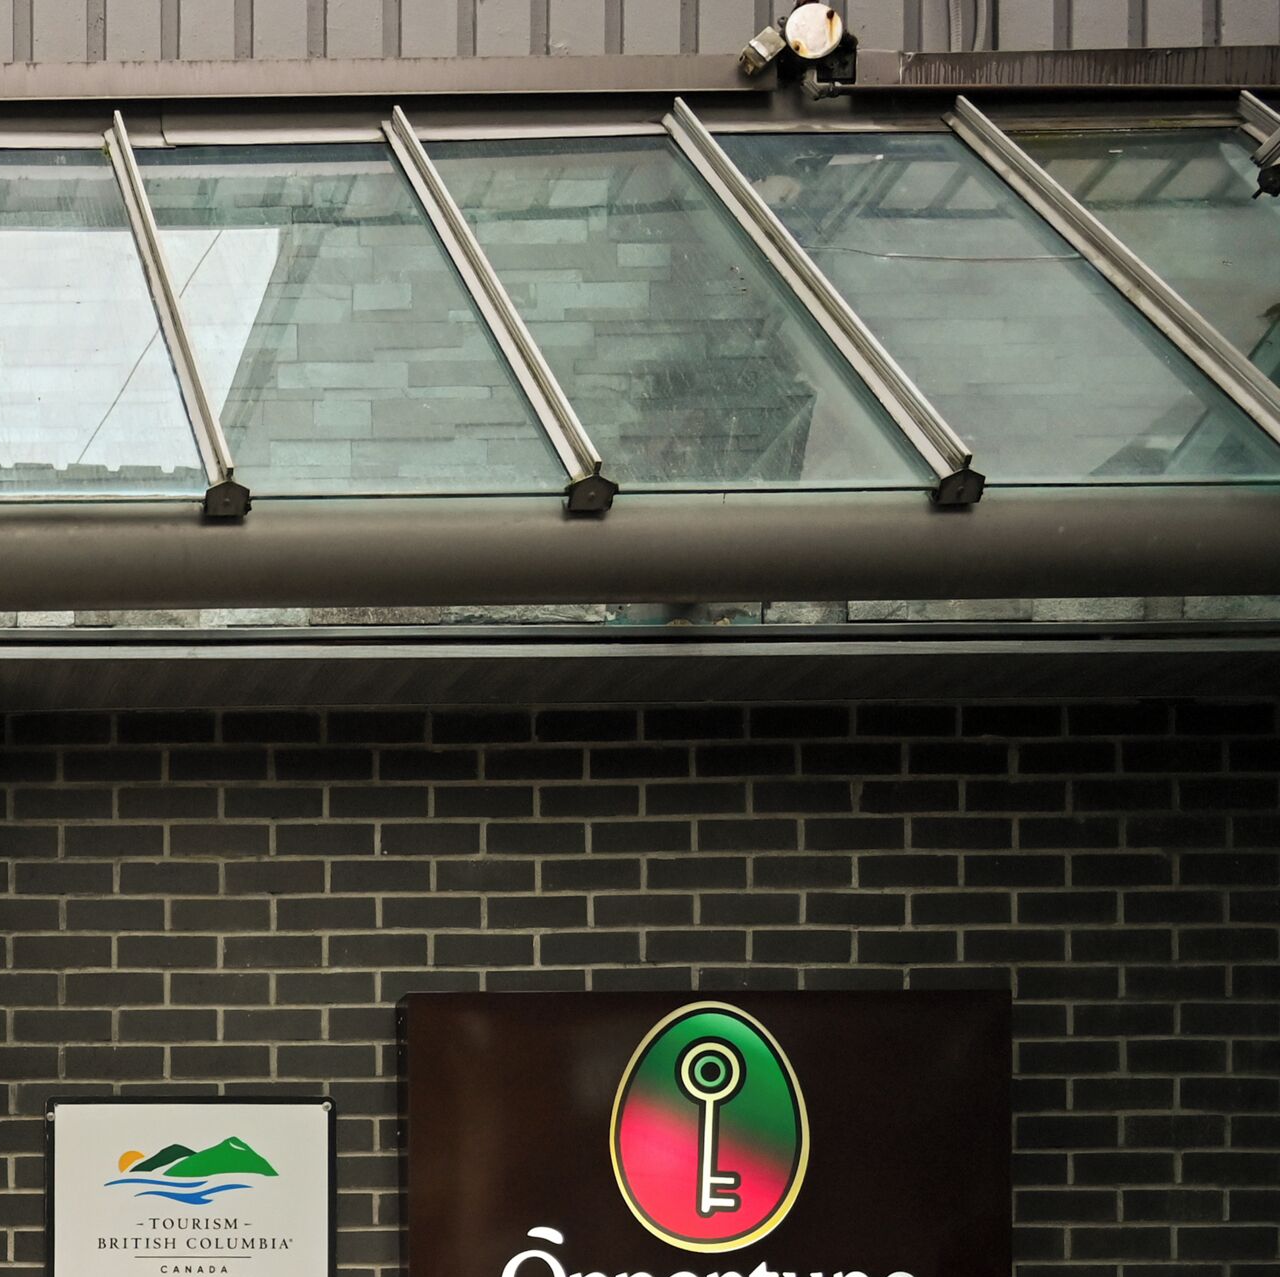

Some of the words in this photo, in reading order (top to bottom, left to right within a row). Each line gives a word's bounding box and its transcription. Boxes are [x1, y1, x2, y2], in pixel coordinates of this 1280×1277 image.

[148, 1218, 239, 1230] TOURISM
[97, 1237, 177, 1250] BRITISH
[160, 1265, 229, 1274] CANADA
